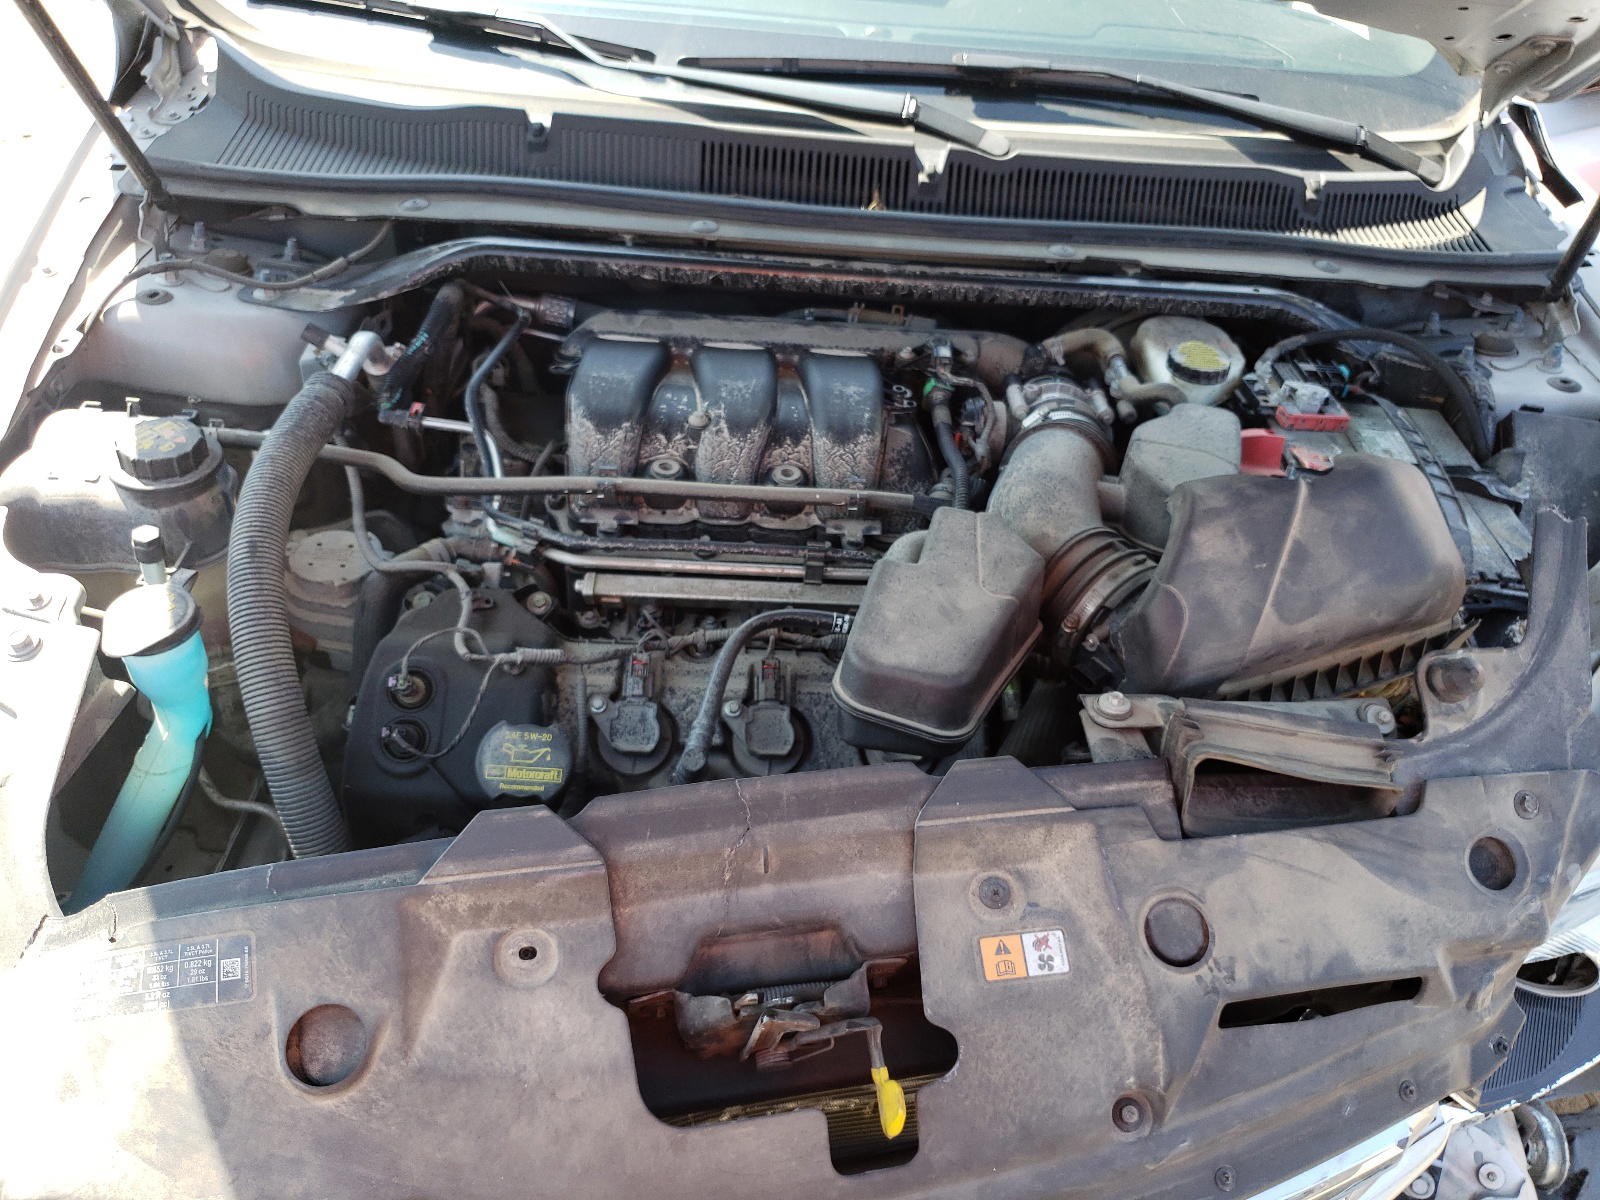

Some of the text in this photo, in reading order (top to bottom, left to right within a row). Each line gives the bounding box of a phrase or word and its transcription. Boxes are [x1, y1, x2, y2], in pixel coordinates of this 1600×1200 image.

[524, 732, 553, 742] 5W-20
[507, 767, 561, 781] Motorcraft
[500, 783, 545, 792] Recommended
[165, 964, 174, 973] kg
[184, 959, 212, 969] 0.822 kg
